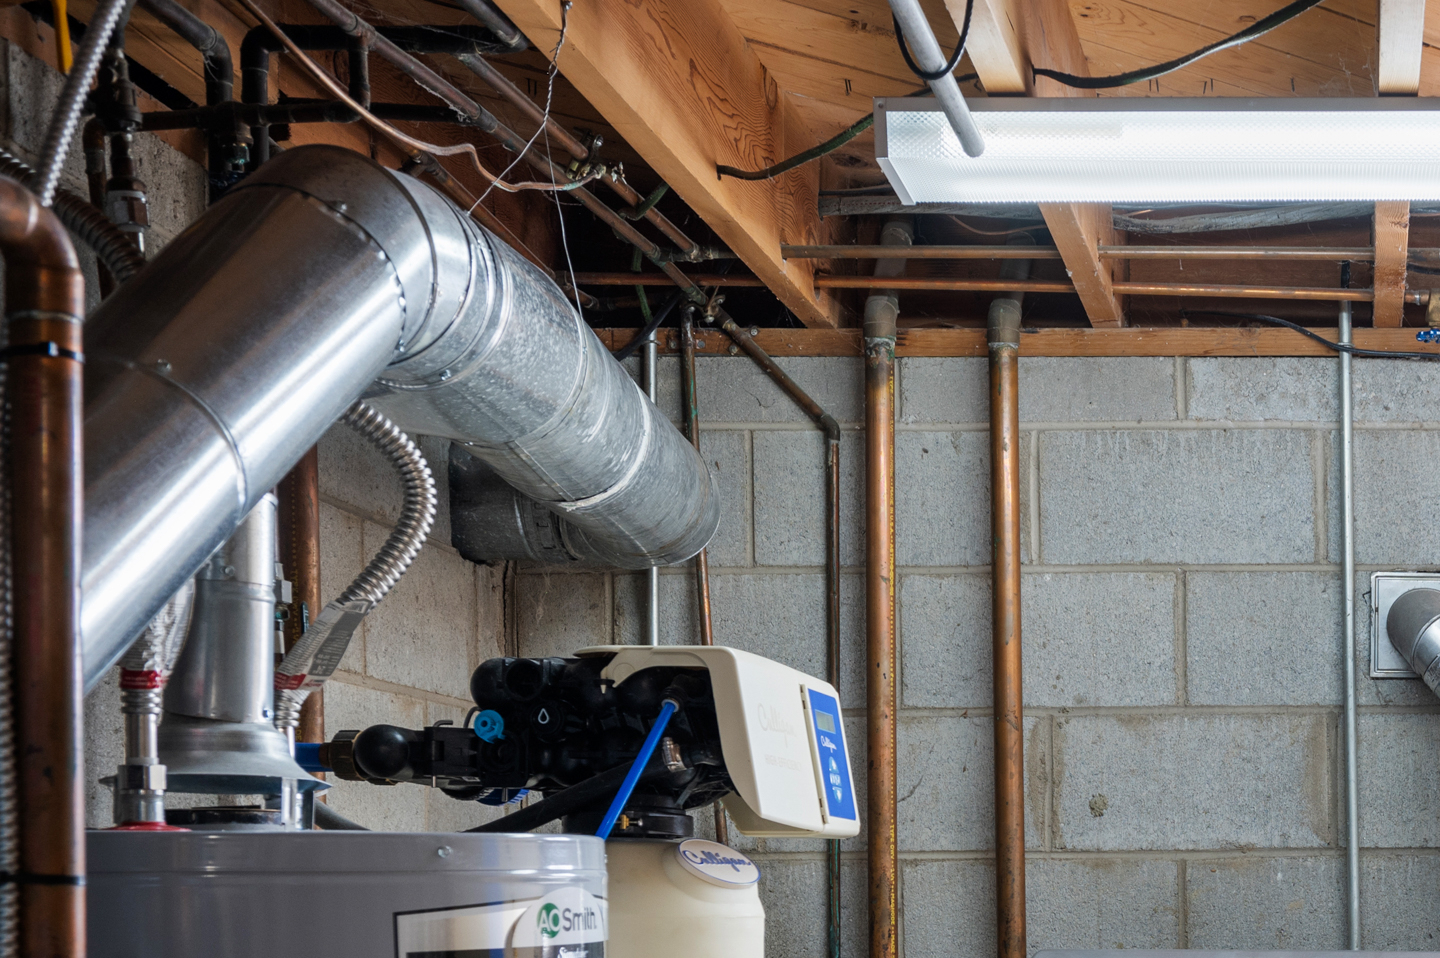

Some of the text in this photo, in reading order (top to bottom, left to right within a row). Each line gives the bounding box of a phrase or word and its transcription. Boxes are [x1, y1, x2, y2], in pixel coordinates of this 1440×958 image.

[758, 703, 797, 748] Culligan
[682, 849, 751, 872] Culligan
[562, 908, 596, 932] Smith
